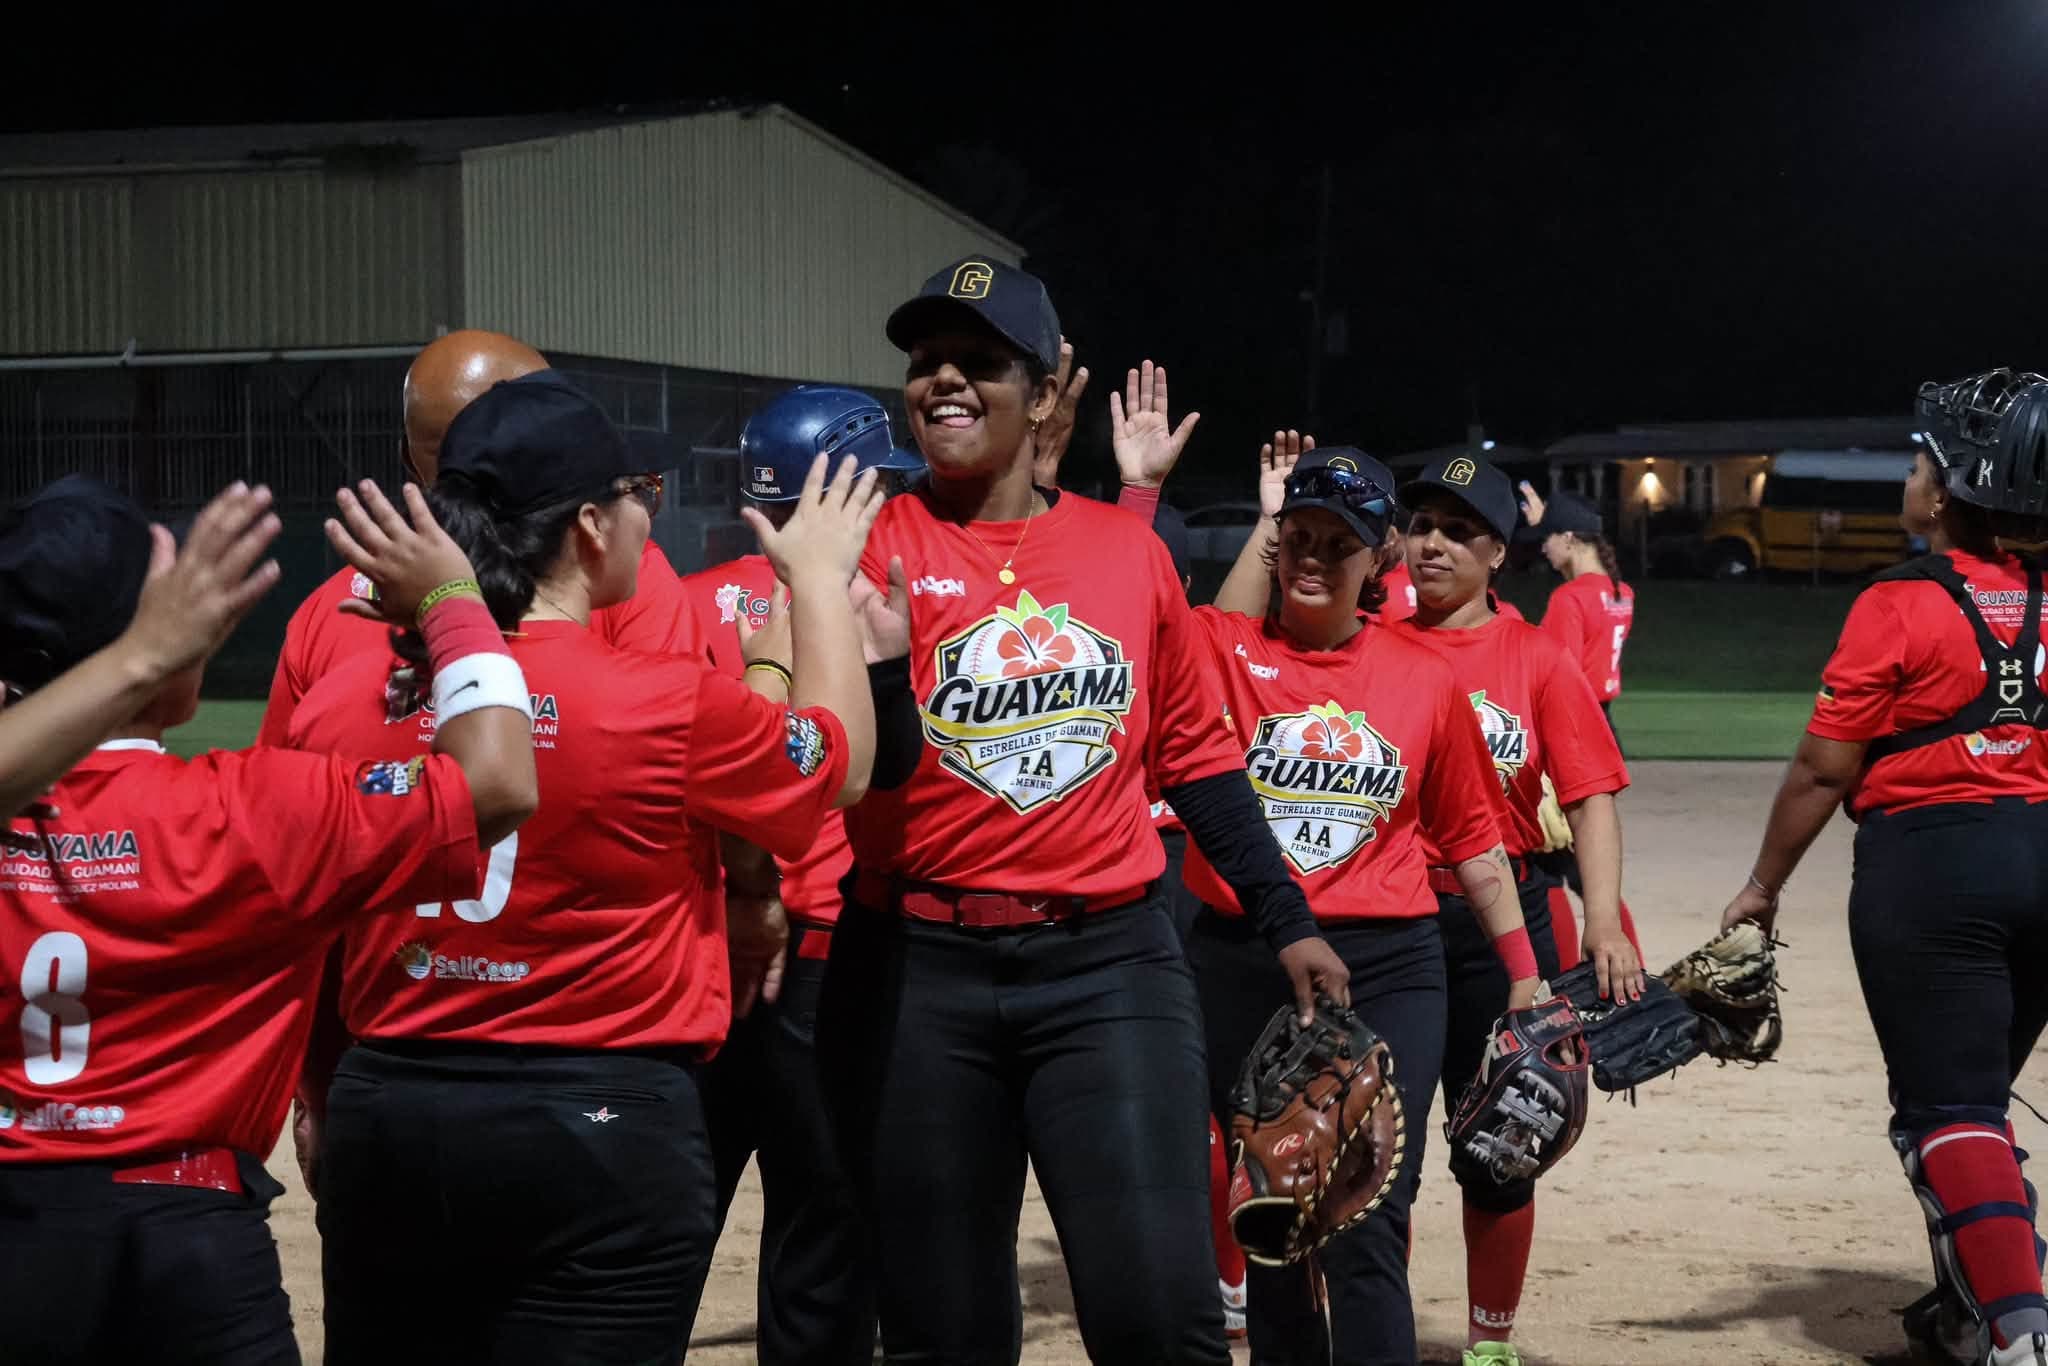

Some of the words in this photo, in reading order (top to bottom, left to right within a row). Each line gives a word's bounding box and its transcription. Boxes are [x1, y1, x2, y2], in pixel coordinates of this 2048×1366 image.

[949, 262, 993, 299] G
[1442, 457, 1476, 485] G
[752, 482, 782, 494] Wilson
[930, 667, 1129, 724] GUAYAMA
[980, 734, 1041, 759] ESTRELLAS
[1248, 749, 1404, 799] GUAYAMA
[1271, 804, 1321, 815] ESTRELLAS
[1324, 807, 1336, 816] DE
[1290, 843, 1330, 858] FEMENINO
[20, 931, 91, 1085] 8
